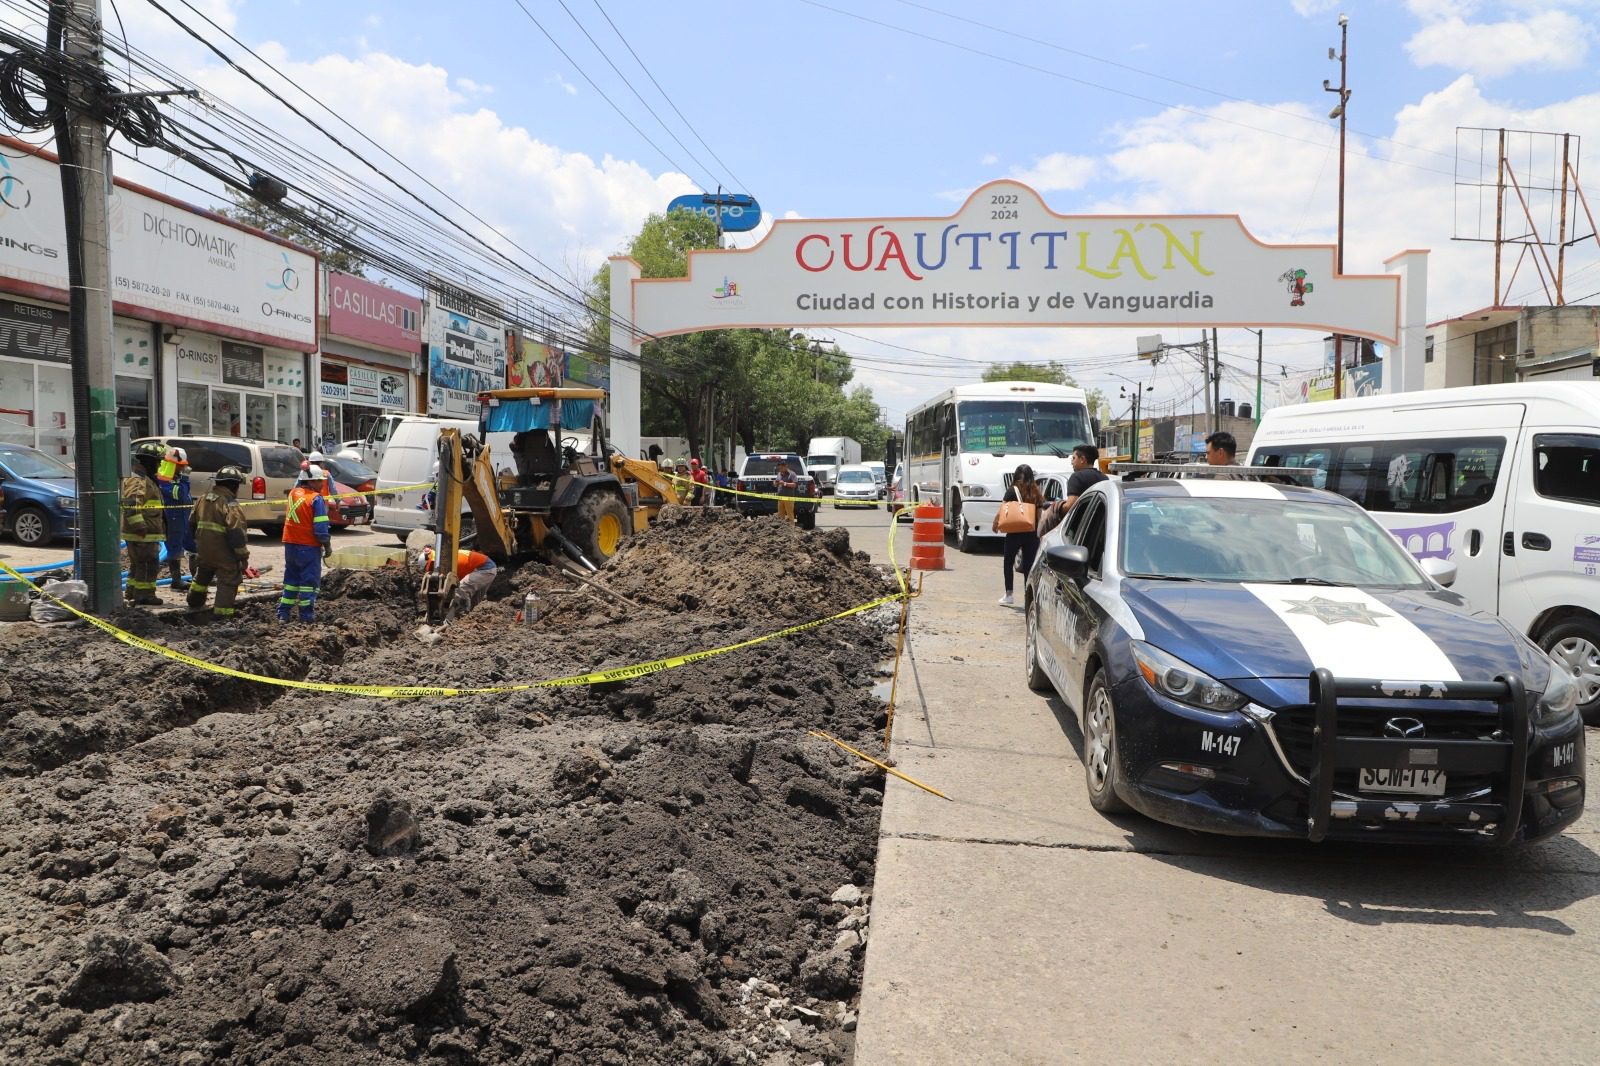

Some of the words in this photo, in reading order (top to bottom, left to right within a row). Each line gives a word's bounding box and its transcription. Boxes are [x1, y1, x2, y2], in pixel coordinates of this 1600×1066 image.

[991, 195, 1018, 204] 2022
[991, 210, 1018, 219] 2024
[143, 212, 236, 259] DICHTOMATIK
[0, 236, 58, 258] INGS
[795, 223, 1215, 281] CUAUTITLÁN
[115, 276, 130, 289] (55)
[193, 296, 206, 308] (55)
[796, 293, 875, 310] Ciudad
[883, 297, 924, 310] con
[932, 293, 1020, 310] Historia
[1028, 297, 1039, 313] y
[1047, 292, 1075, 309] de
[1083, 292, 1214, 313] Vanguardia
[14, 304, 53, 319] RETENES
[261, 302, 312, 324] O-RINGS
[333, 286, 395, 325] CASILLAS
[176, 348, 218, 364] O-RINGS?
[450, 339, 474, 360] Parker
[475, 349, 493, 365] Store
[320, 385, 346, 397] 620-2914
[1201, 731, 1241, 757] M-147
[1553, 742, 1575, 767] M-147
[1363, 768, 1441, 788] SCM-147
